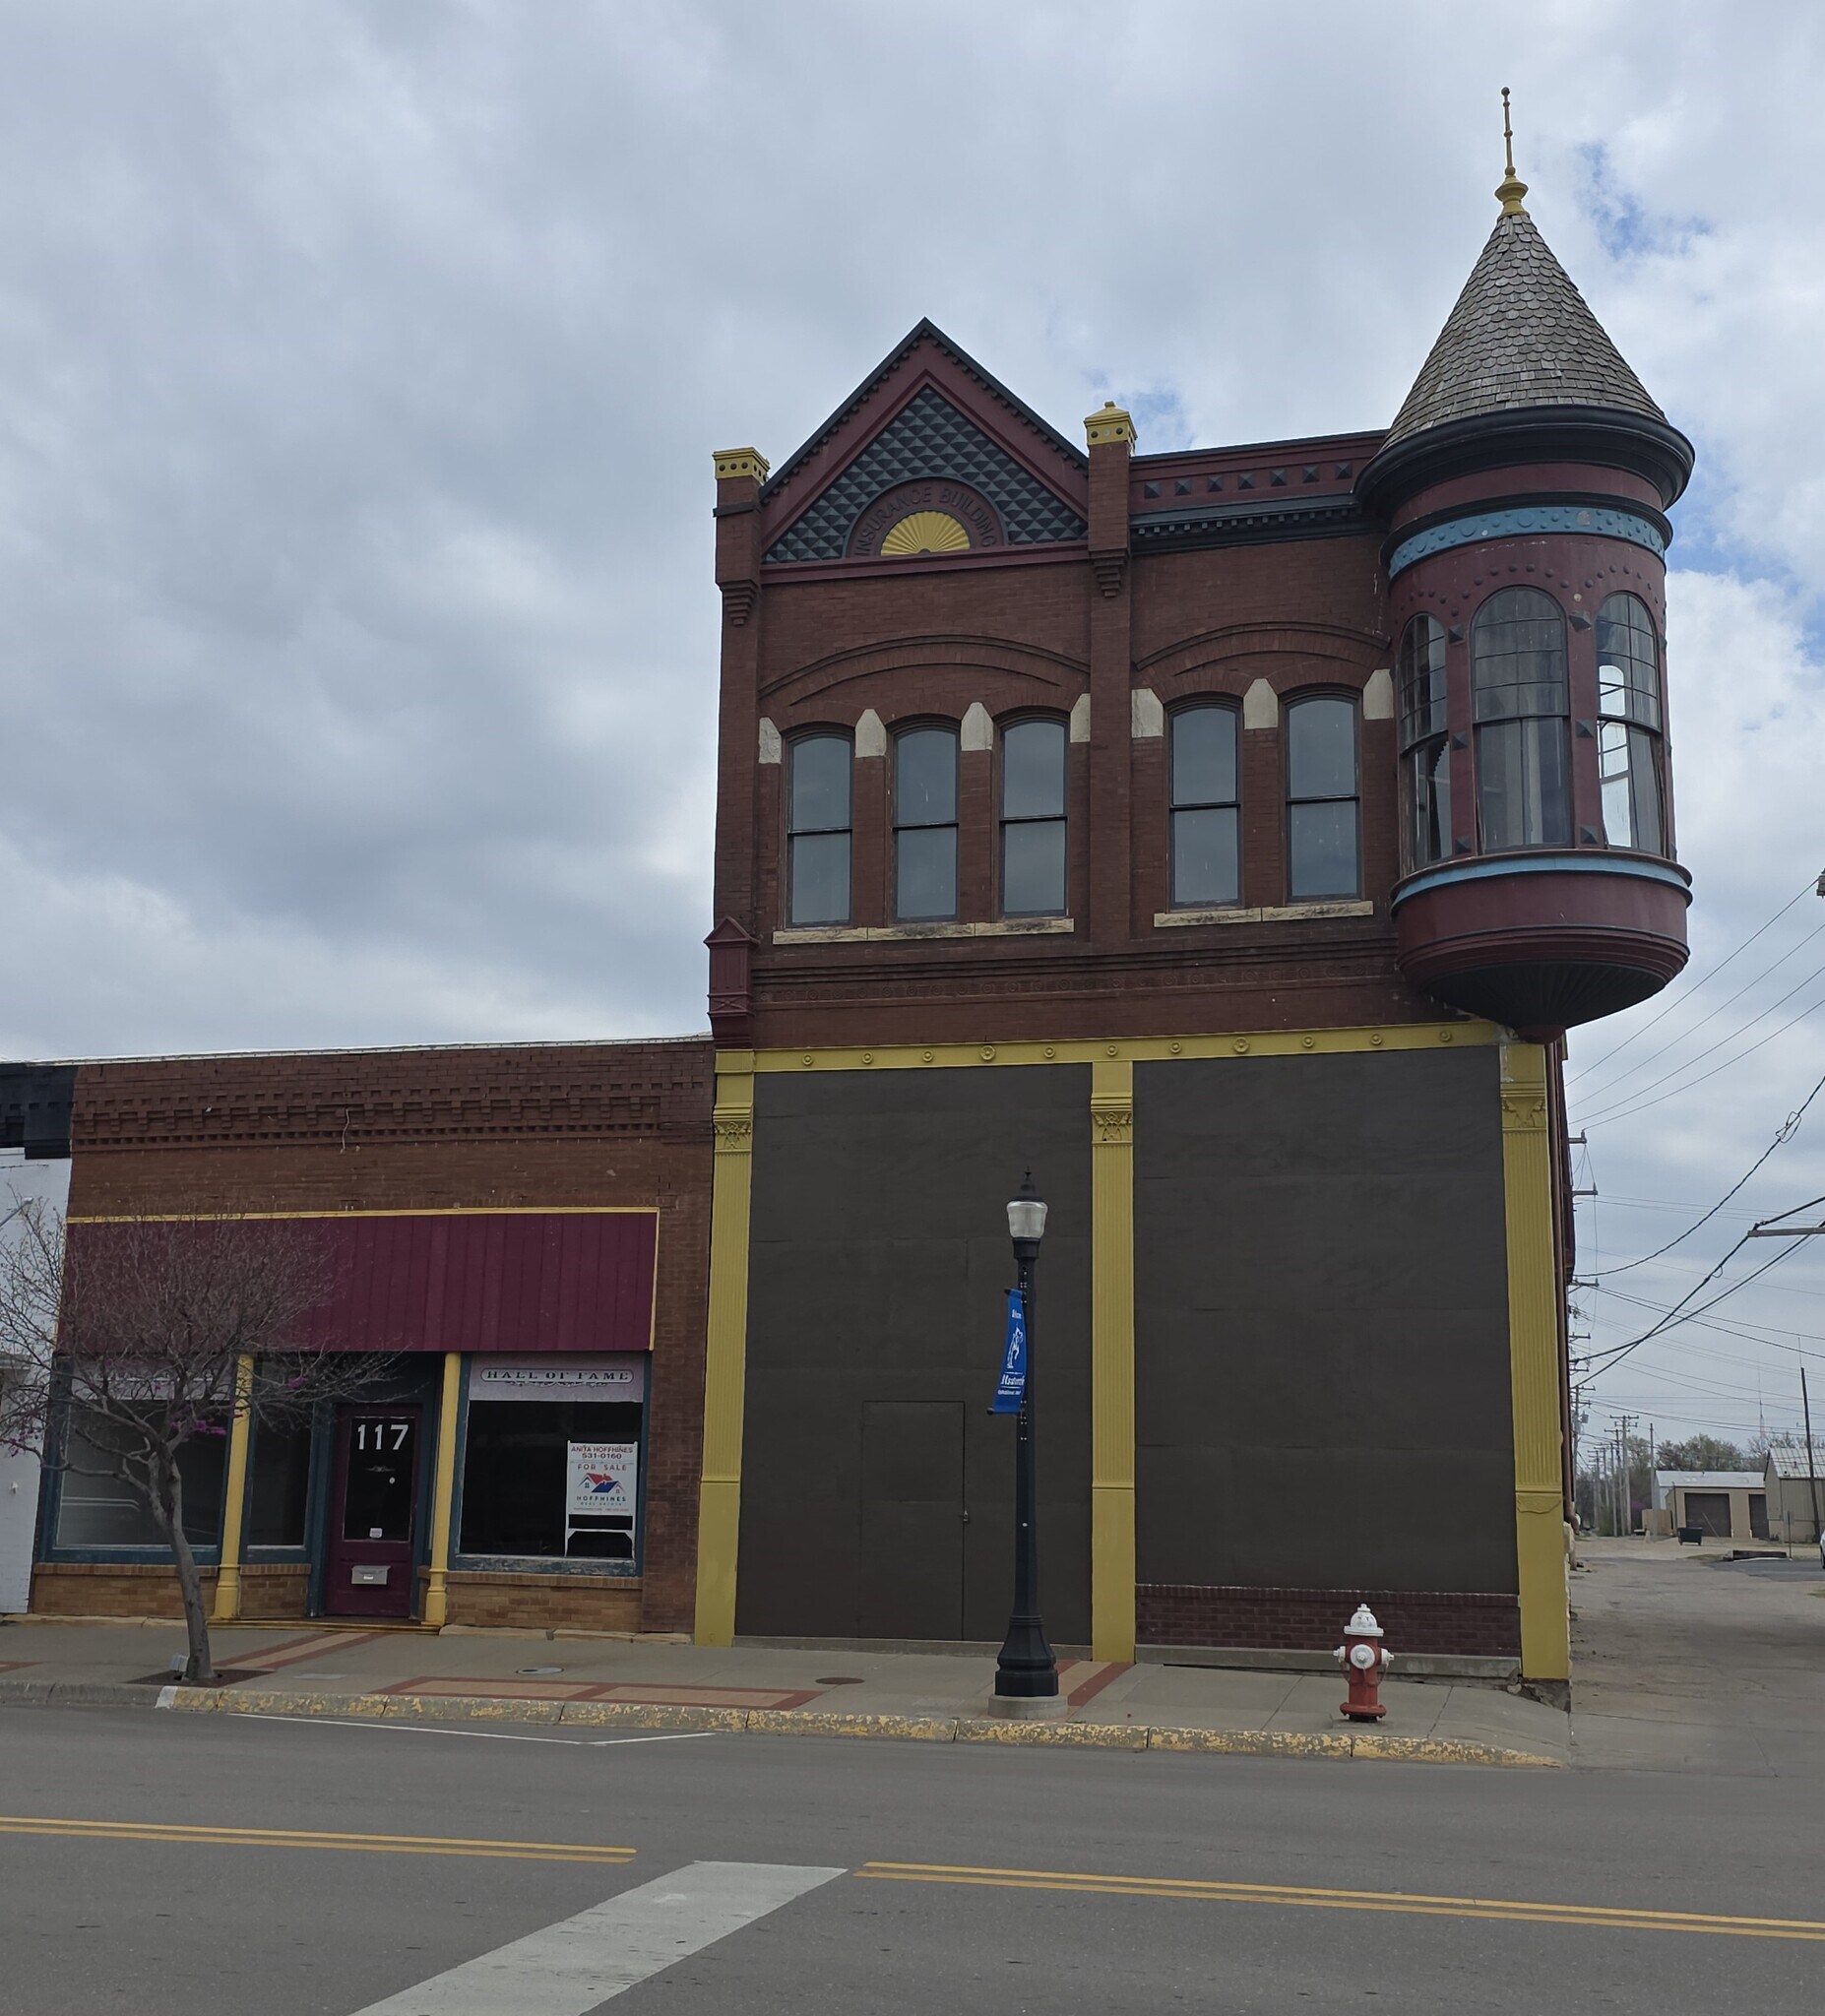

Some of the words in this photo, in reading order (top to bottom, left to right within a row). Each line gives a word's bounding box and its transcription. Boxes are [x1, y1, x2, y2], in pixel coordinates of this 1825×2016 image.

[854, 486, 932, 557] INSURANCE
[939, 487, 998, 548] BUILDING
[486, 1370, 538, 1379] HALL
[545, 1371, 569, 1380] OF
[578, 1371, 629, 1380] FAME
[357, 1424, 409, 1450] 117
